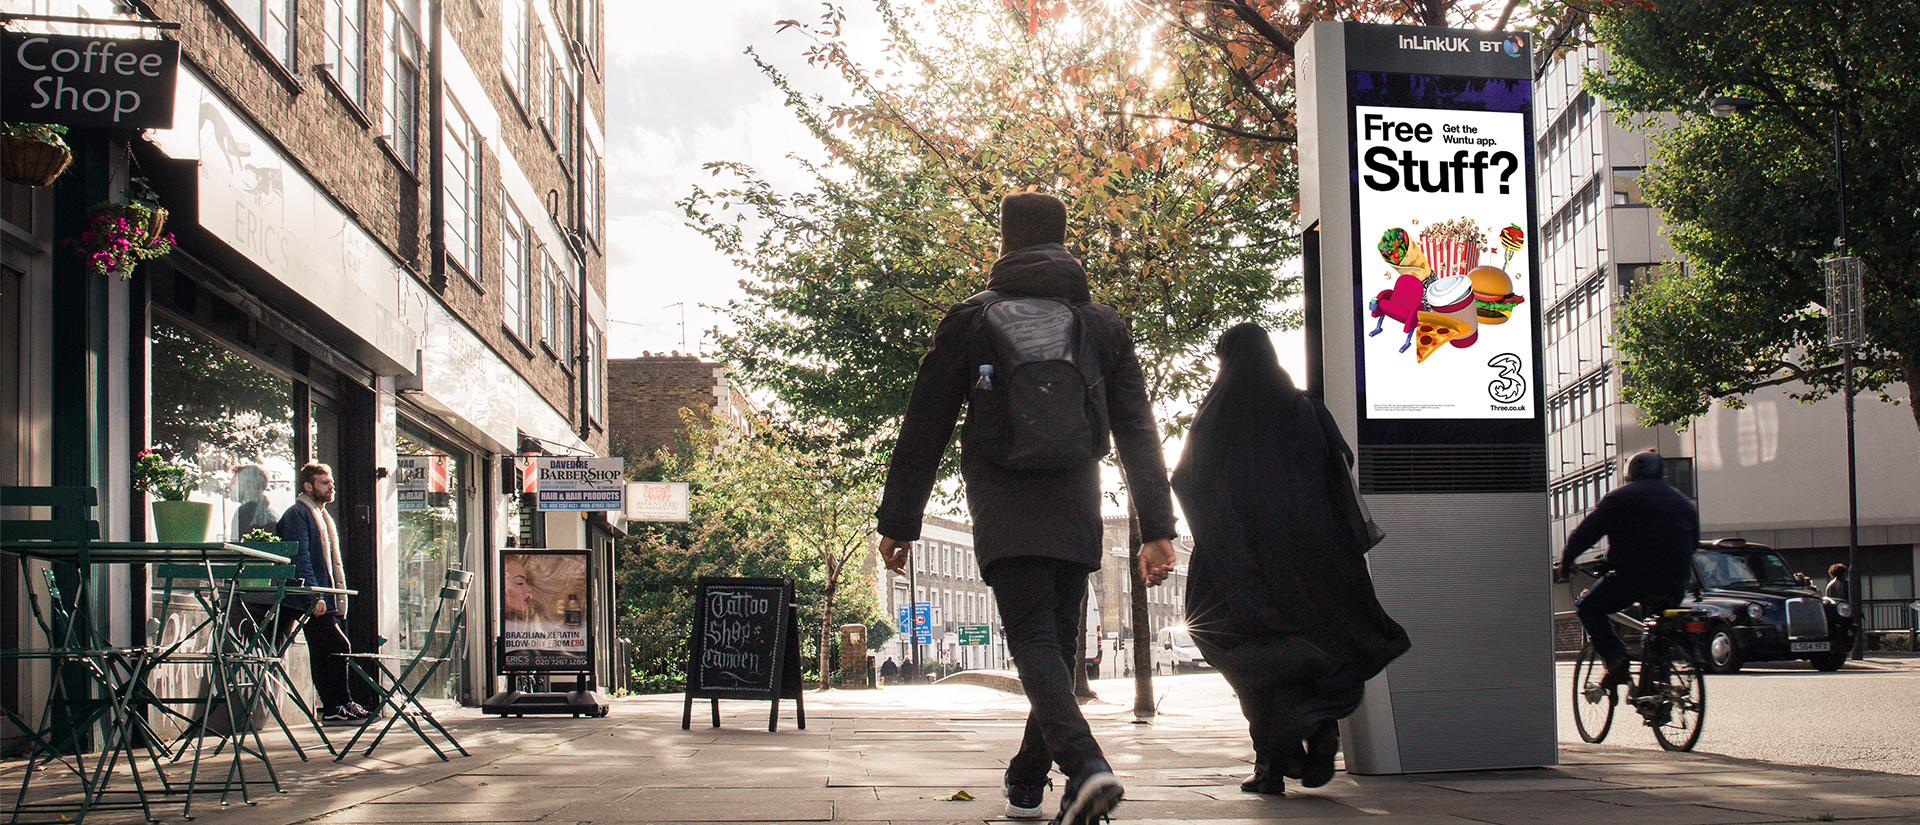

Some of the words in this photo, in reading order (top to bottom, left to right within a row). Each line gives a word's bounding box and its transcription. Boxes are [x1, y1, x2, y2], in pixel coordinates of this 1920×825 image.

[1399, 35, 1470, 53] InLinkUK
[1479, 40, 1502, 53] BT
[17, 37, 162, 77] Coffee
[30, 76, 141, 122] Shop
[1364, 113, 1433, 143] Free
[1442, 124, 1460, 134] Get
[1462, 125, 1478, 134] the
[1442, 134, 1474, 145] Wuntu
[1476, 138, 1497, 147] app.
[1363, 145, 1518, 195] Stuff?
[235, 199, 289, 275] ERIC'S
[1490, 404, 1526, 412] Three.co.uk
[541, 492, 558, 500] HAIR
[565, 492, 582, 500] HAIR
[583, 492, 620, 500] PRODUCTS
[707, 591, 768, 618] Tattoo
[505, 631, 546, 639] BRAZILIAN
[548, 631, 580, 639] KERATIN
[571, 639, 585, 647] £80
[505, 655, 530, 663] ERIC'S
